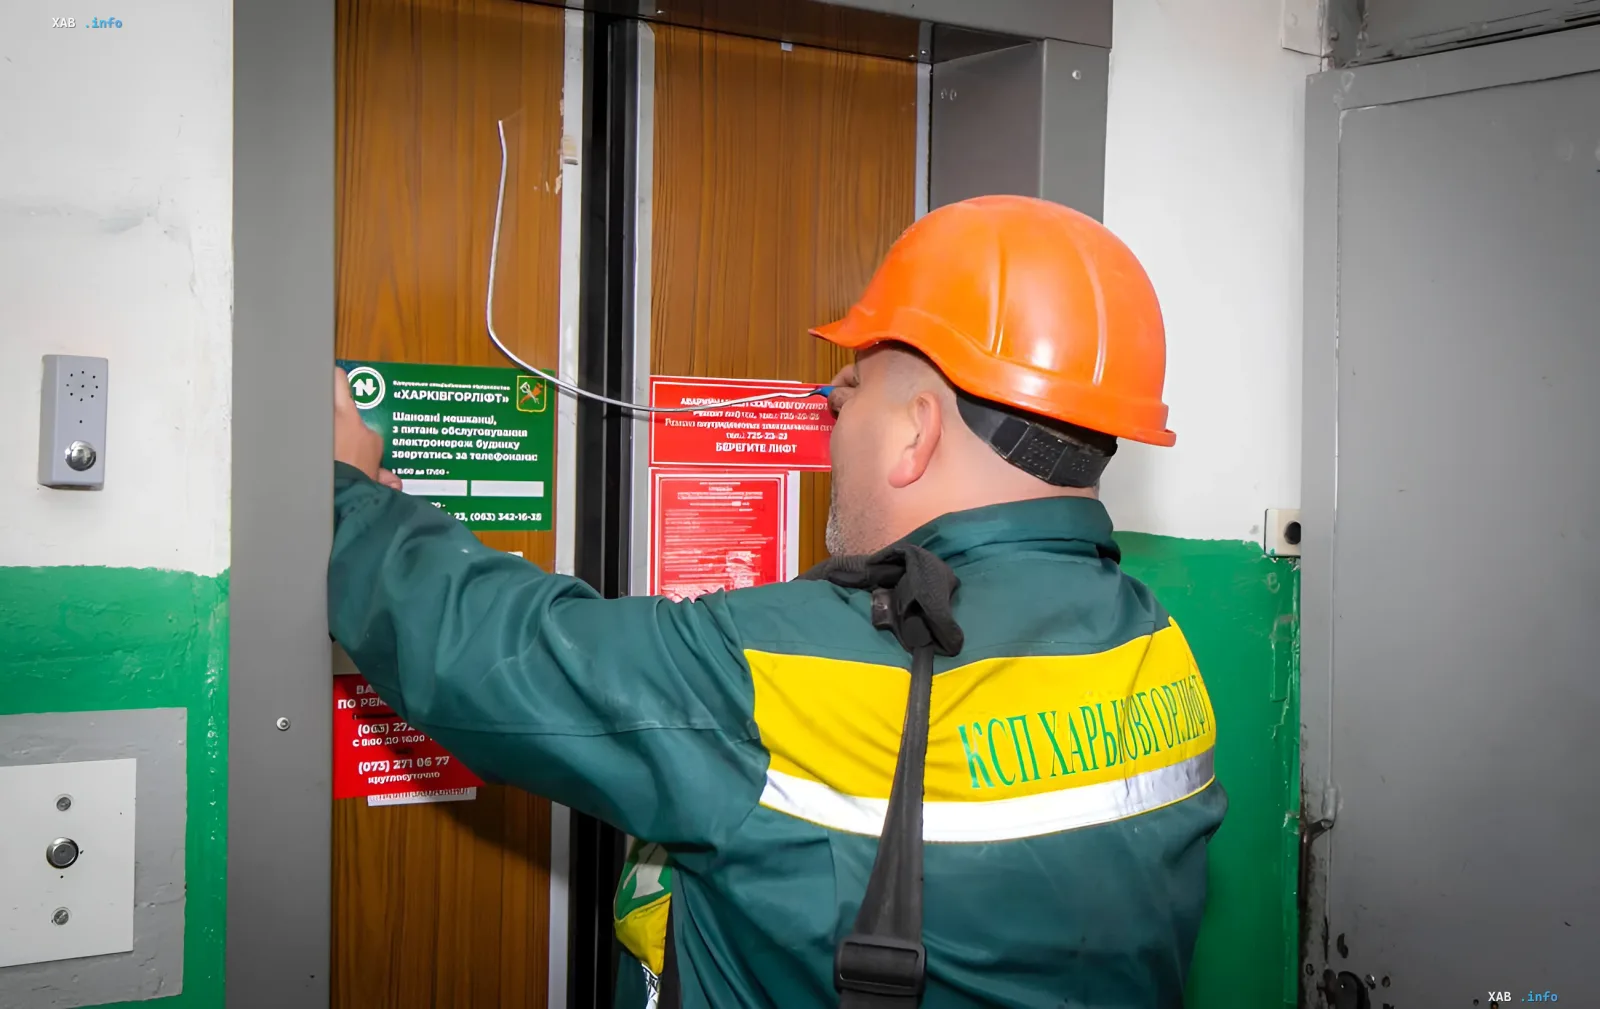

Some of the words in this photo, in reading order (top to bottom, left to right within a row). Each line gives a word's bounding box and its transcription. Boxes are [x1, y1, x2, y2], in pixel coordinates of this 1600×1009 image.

[393, 389, 510, 403] «ХАРКІВГОРЛІФТ»
[392, 411, 440, 423] Шановні
[443, 415, 497, 426] мешканці,
[401, 426, 439, 435] питань
[441, 426, 528, 438] обслуговування
[392, 438, 473, 449] електромереж
[476, 439, 520, 450] будинку
[715, 442, 766, 453] БЕРЕГИТЕ
[768, 443, 798, 454] ЛИФТ
[392, 450, 453, 460] звертатись
[455, 452, 468, 460] за
[337, 698, 356, 710] ПО
[957, 715, 1041, 789] КСП
[358, 760, 390, 775] (073)
[392, 758, 413, 770] 271
[416, 757, 432, 768] 06
[435, 755, 450, 766] 77
